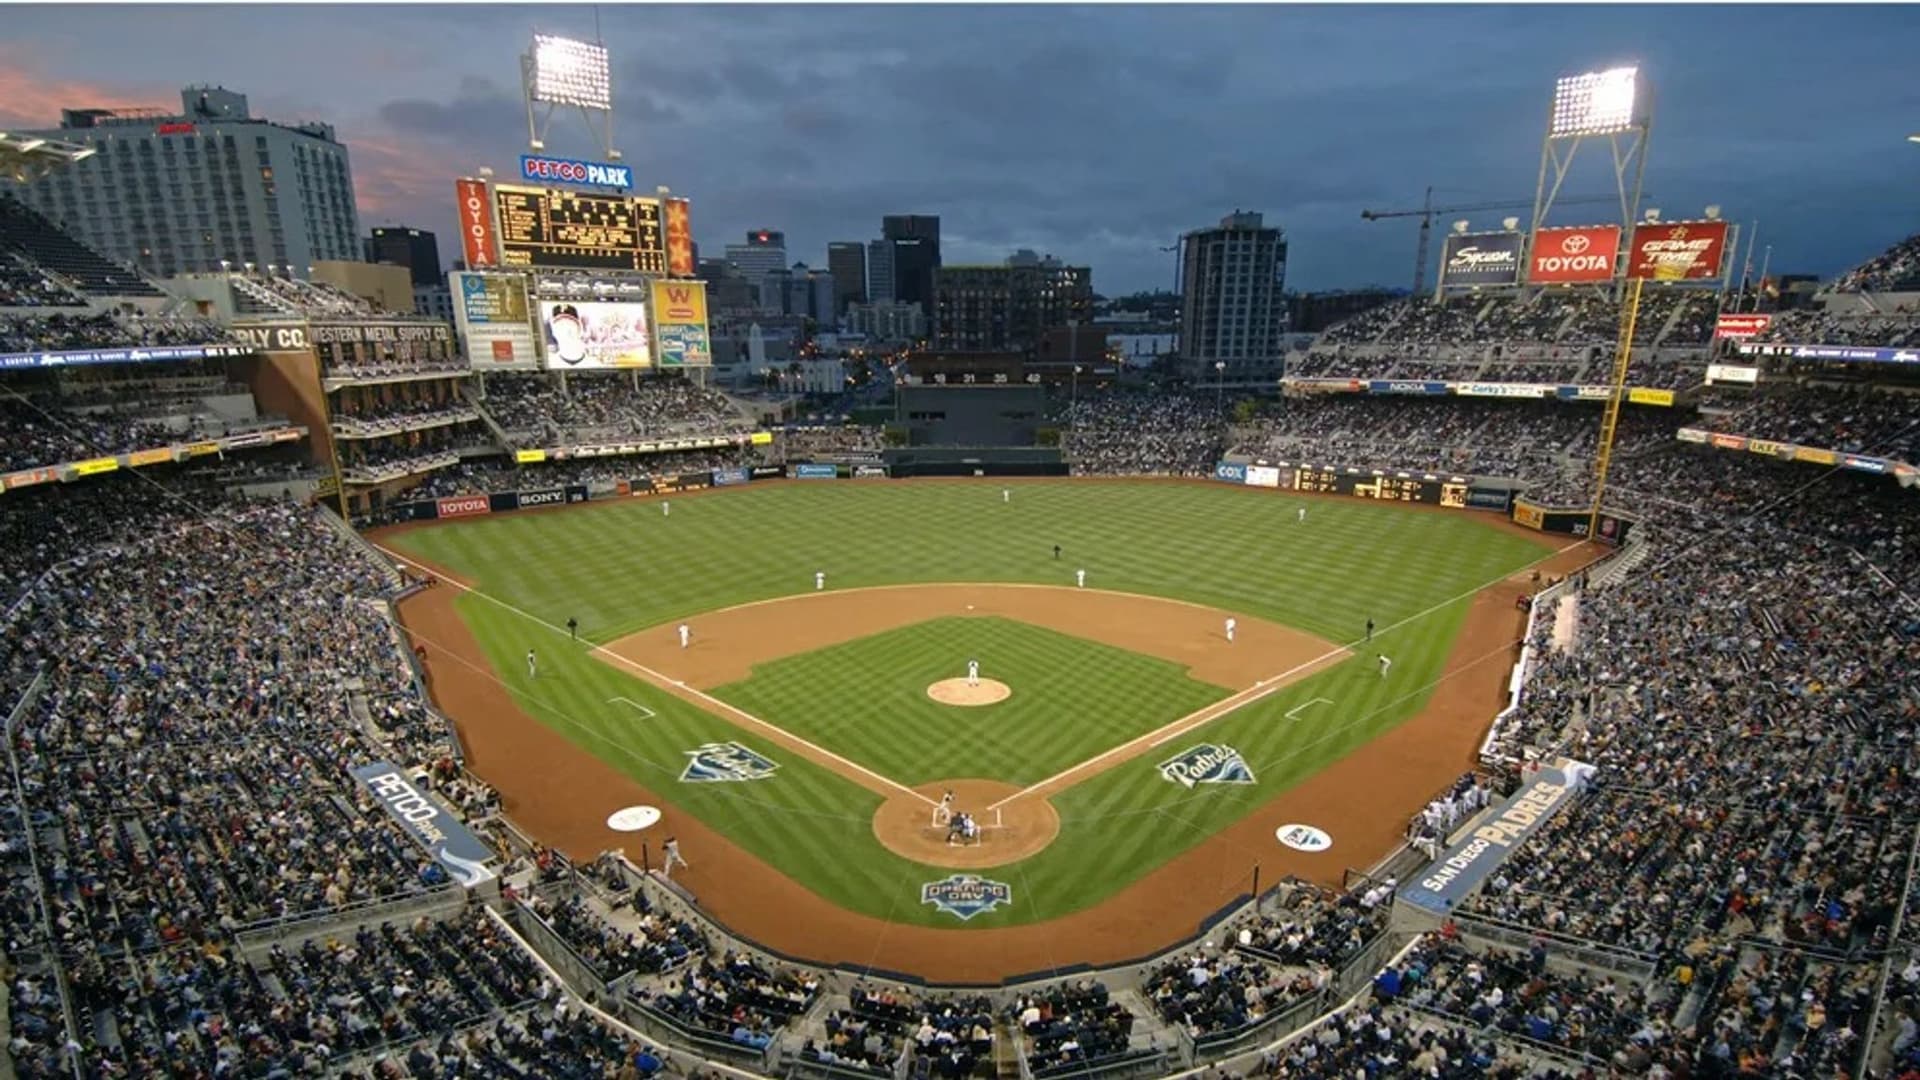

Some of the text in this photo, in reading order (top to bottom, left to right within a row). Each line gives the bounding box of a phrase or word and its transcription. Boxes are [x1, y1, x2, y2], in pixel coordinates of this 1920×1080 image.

[526, 159, 629, 186] PETCO PARK
[467, 184, 488, 265] TOYOTA
[1641, 238, 1714, 252] GAME
[1449, 246, 1515, 268] Sycuan
[1537, 255, 1608, 272] TOYOTA
[1646, 251, 1701, 264] TIME
[277, 328, 311, 348] CO.
[311, 327, 362, 343] WESTERN
[365, 327, 397, 342] METAL
[399, 327, 431, 342] SUPPLY
[1026, 373, 1040, 383] 42
[1390, 383, 1426, 392] NOKIA
[441, 500, 487, 513] TOYOTA
[520, 492, 562, 504] SONY
[1162, 744, 1237, 789] Padres
[367, 772, 438, 823] PETCO
[1422, 781, 1568, 892] SAN DIEGO PADRES
